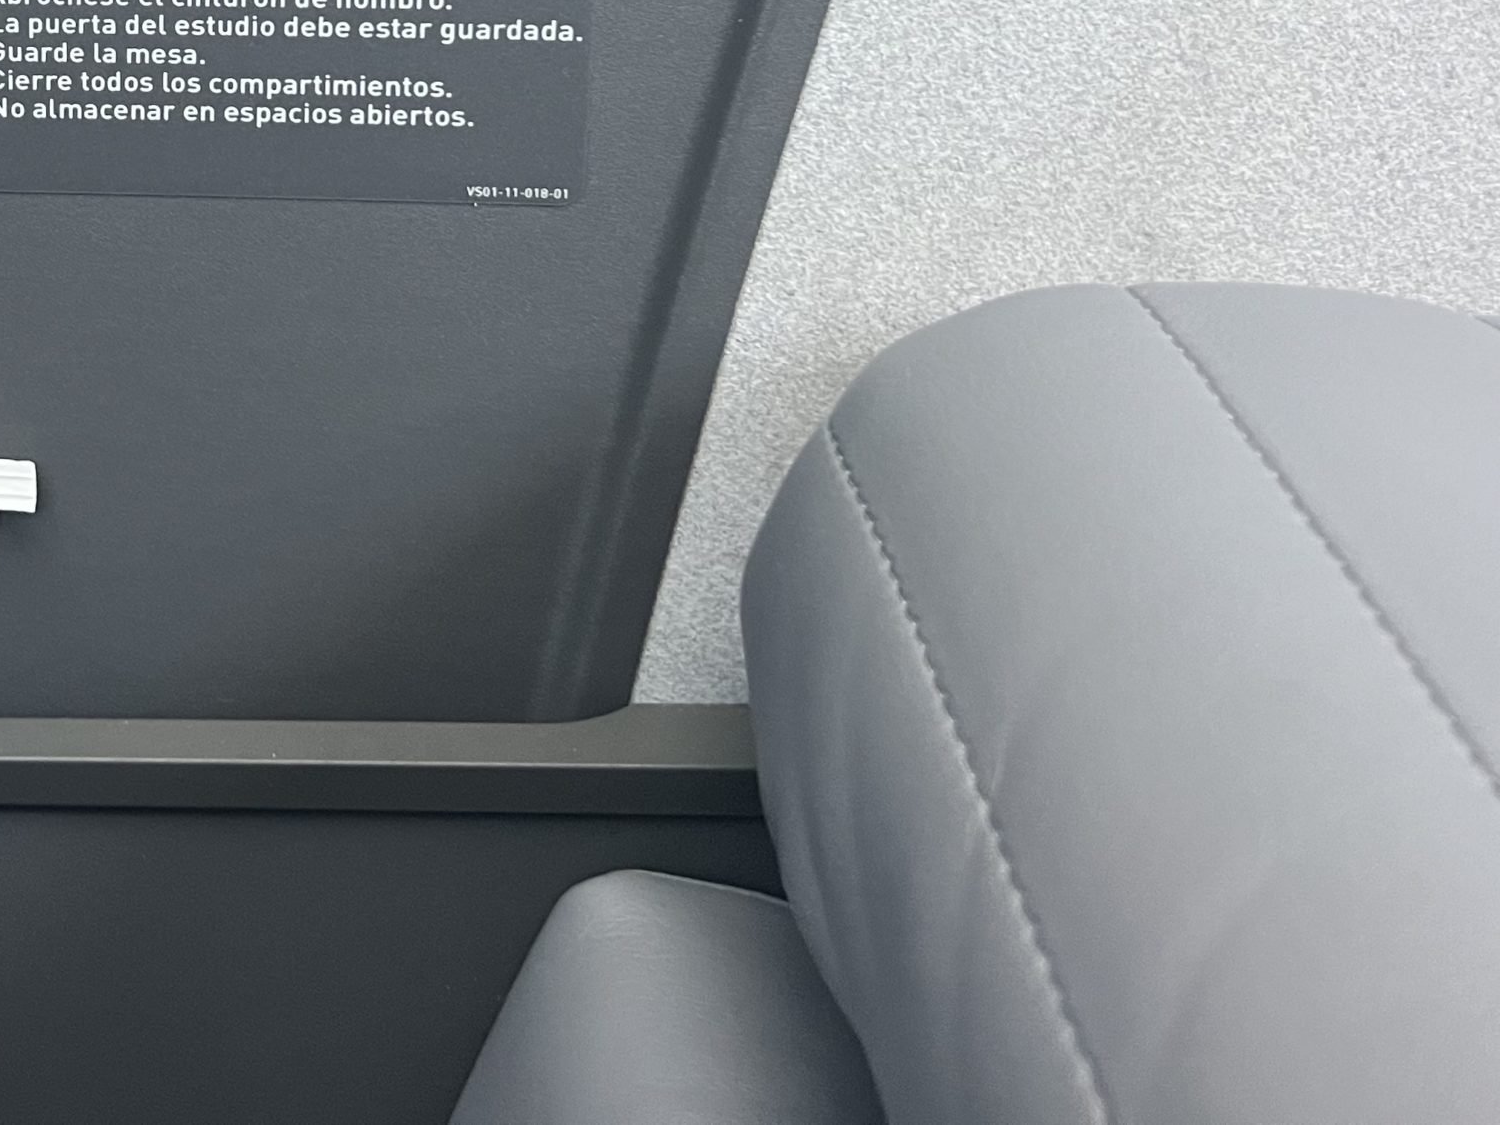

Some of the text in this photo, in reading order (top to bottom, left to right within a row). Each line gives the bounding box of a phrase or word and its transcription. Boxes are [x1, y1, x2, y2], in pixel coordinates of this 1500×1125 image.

[28, 14, 117, 39] puerta
[124, 13, 167, 36] del
[174, 15, 275, 37] estudio
[283, 15, 351, 38] debe
[358, 18, 433, 39] estar
[440, 18, 584, 45] guardada.
[93, 42, 117, 64] la
[126, 47, 206, 65] mesa.
[80, 70, 154, 93] todos
[162, 71, 202, 94] los
[208, 74, 453, 100] compartimientos.
[32, 98, 176, 121] almacenar
[183, 105, 215, 122] en
[223, 102, 343, 129] espacios
[349, 103, 474, 128] abiertos.
[466, 185, 569, 200] VS01-11-018-01
